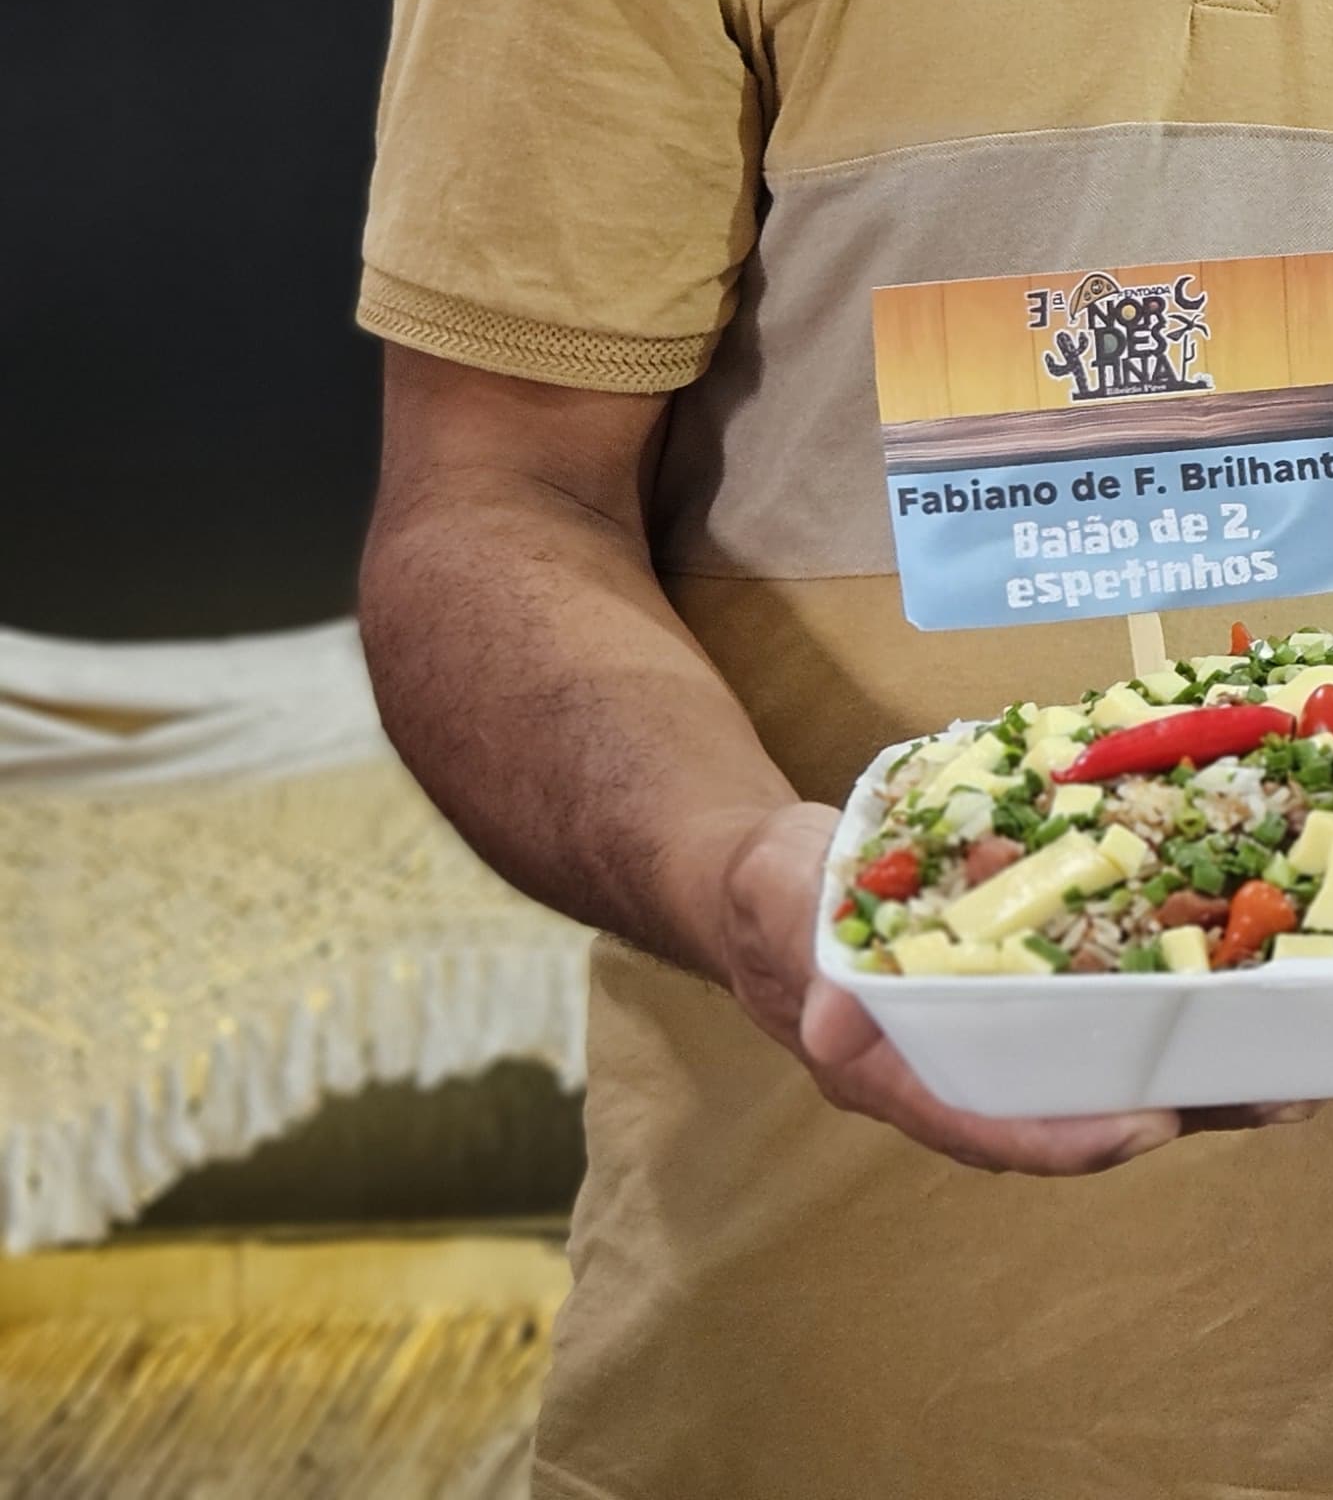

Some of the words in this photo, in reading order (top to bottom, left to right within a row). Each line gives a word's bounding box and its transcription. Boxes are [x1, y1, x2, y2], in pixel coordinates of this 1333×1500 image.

[897, 480, 1057, 516] Fabiano
[1071, 470, 1121, 502] de
[1135, 466, 1167, 496] F.
[1013, 516, 1139, 560] Baião
[1150, 510, 1208, 544] de
[1221, 503, 1262, 541] 2,
[1006, 549, 1279, 609] espetinhos
